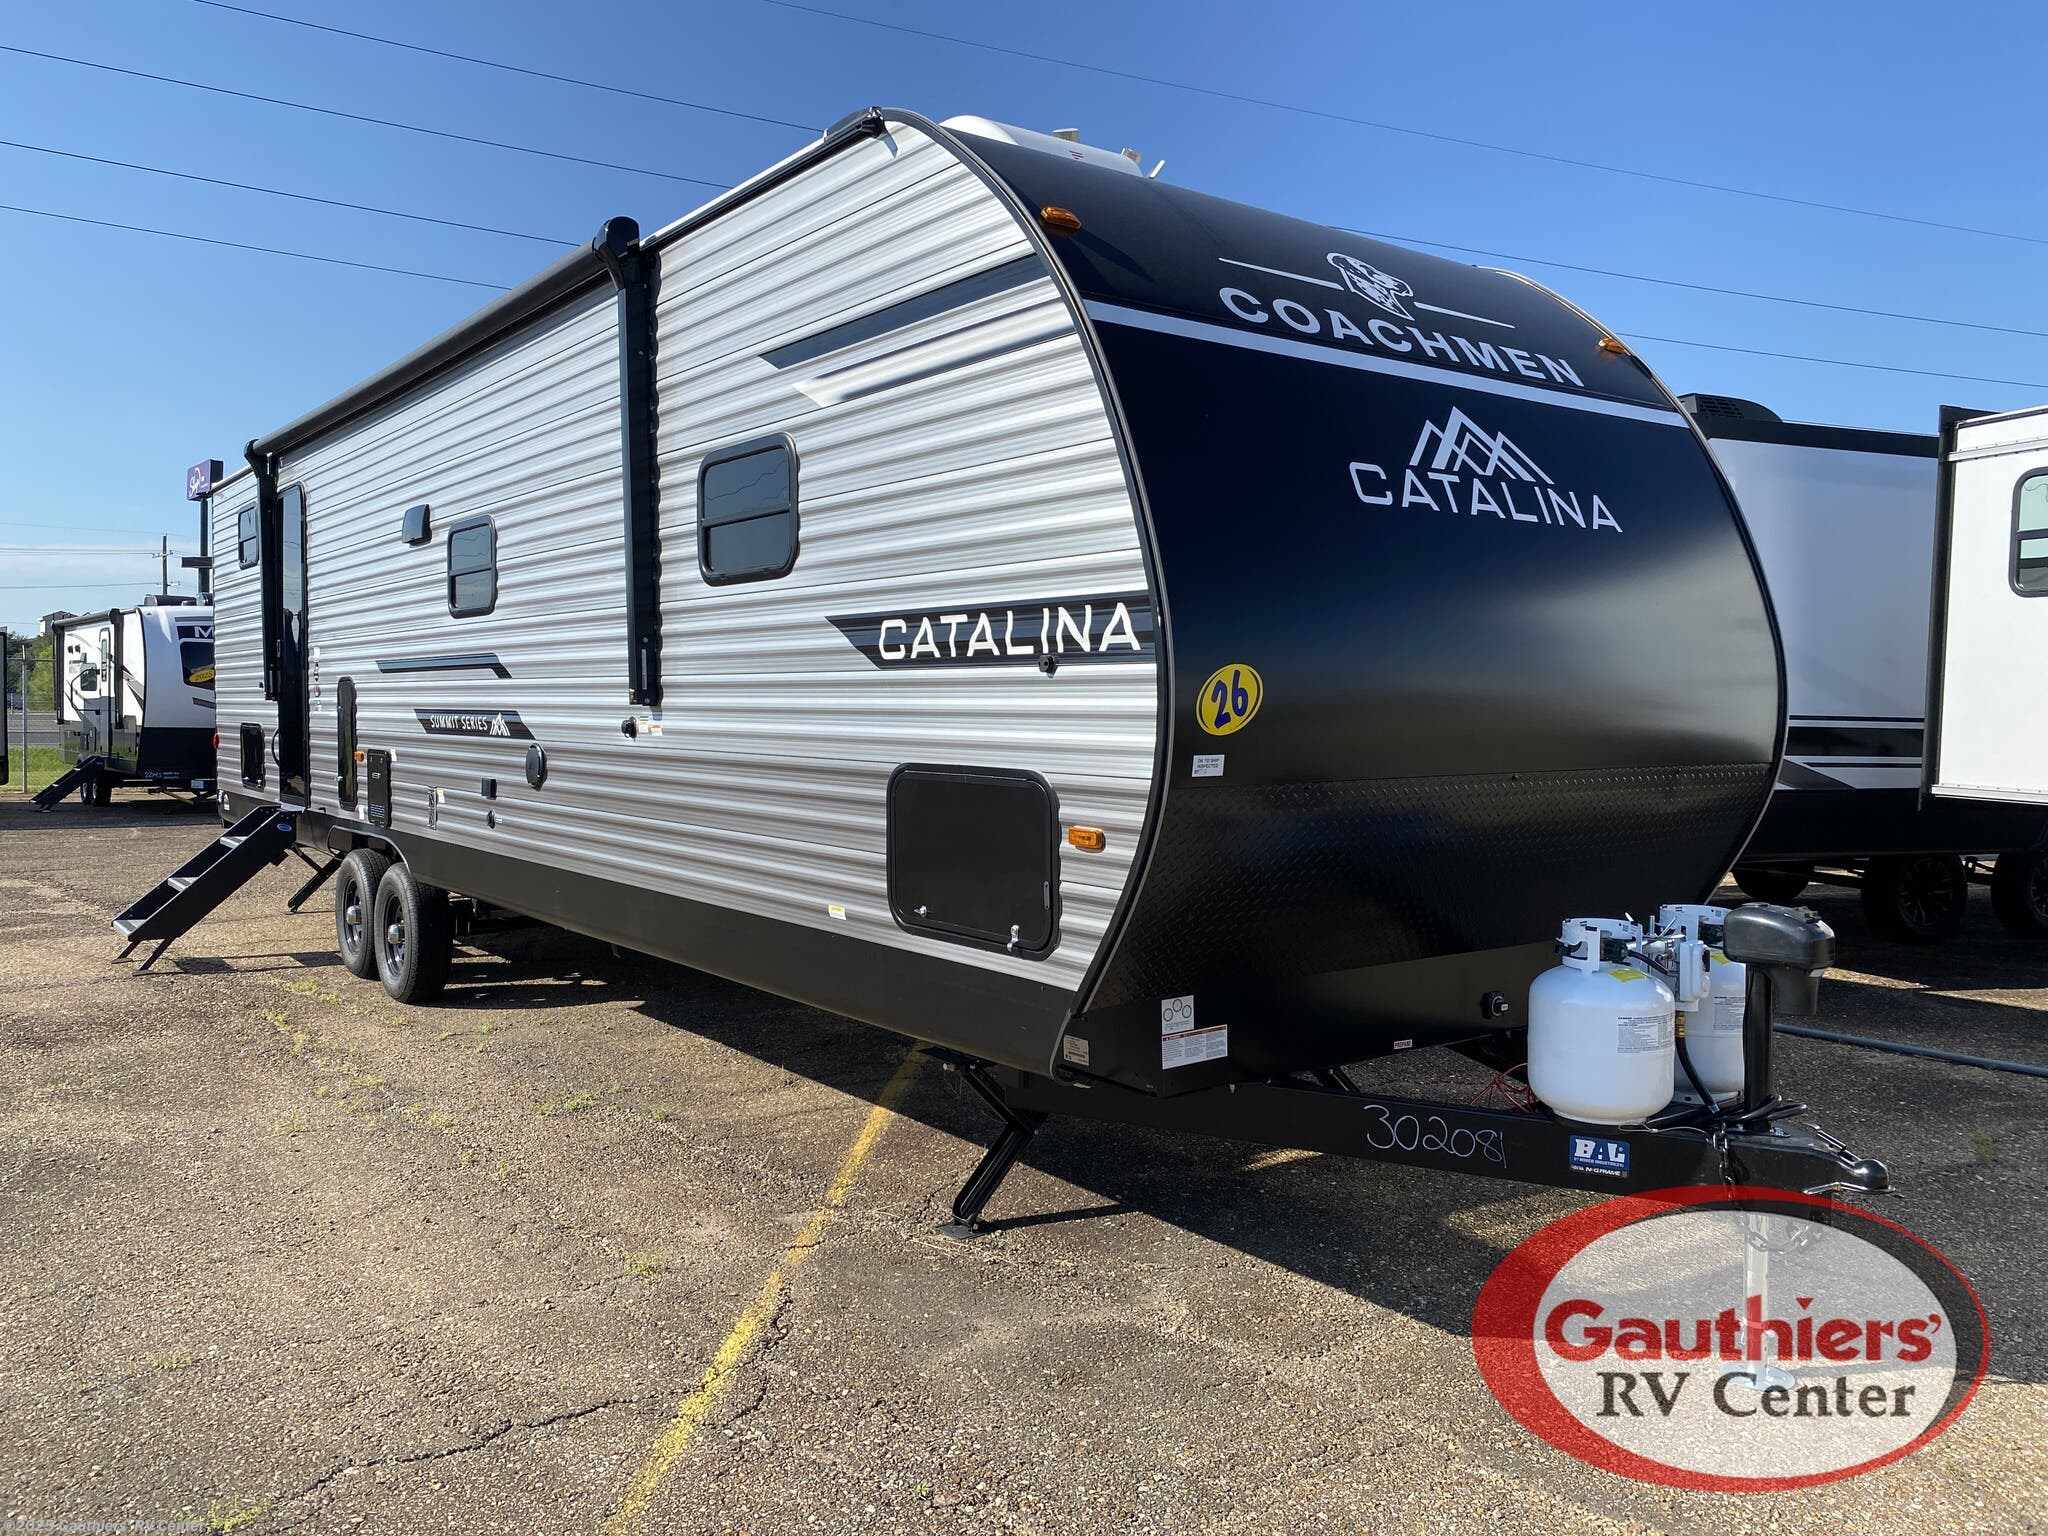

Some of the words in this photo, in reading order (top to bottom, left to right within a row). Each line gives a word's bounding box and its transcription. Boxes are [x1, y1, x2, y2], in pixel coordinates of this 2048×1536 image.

[1218, 286, 1584, 388] COACHMEN
[1348, 461, 1623, 534] CATALINA
[878, 601, 1142, 660] CATALINA
[430, 714, 459, 729] SUMMIT
[462, 715, 488, 731] SERIES
[1211, 669, 1249, 730] 26
[1363, 1104, 1507, 1169] 302081
